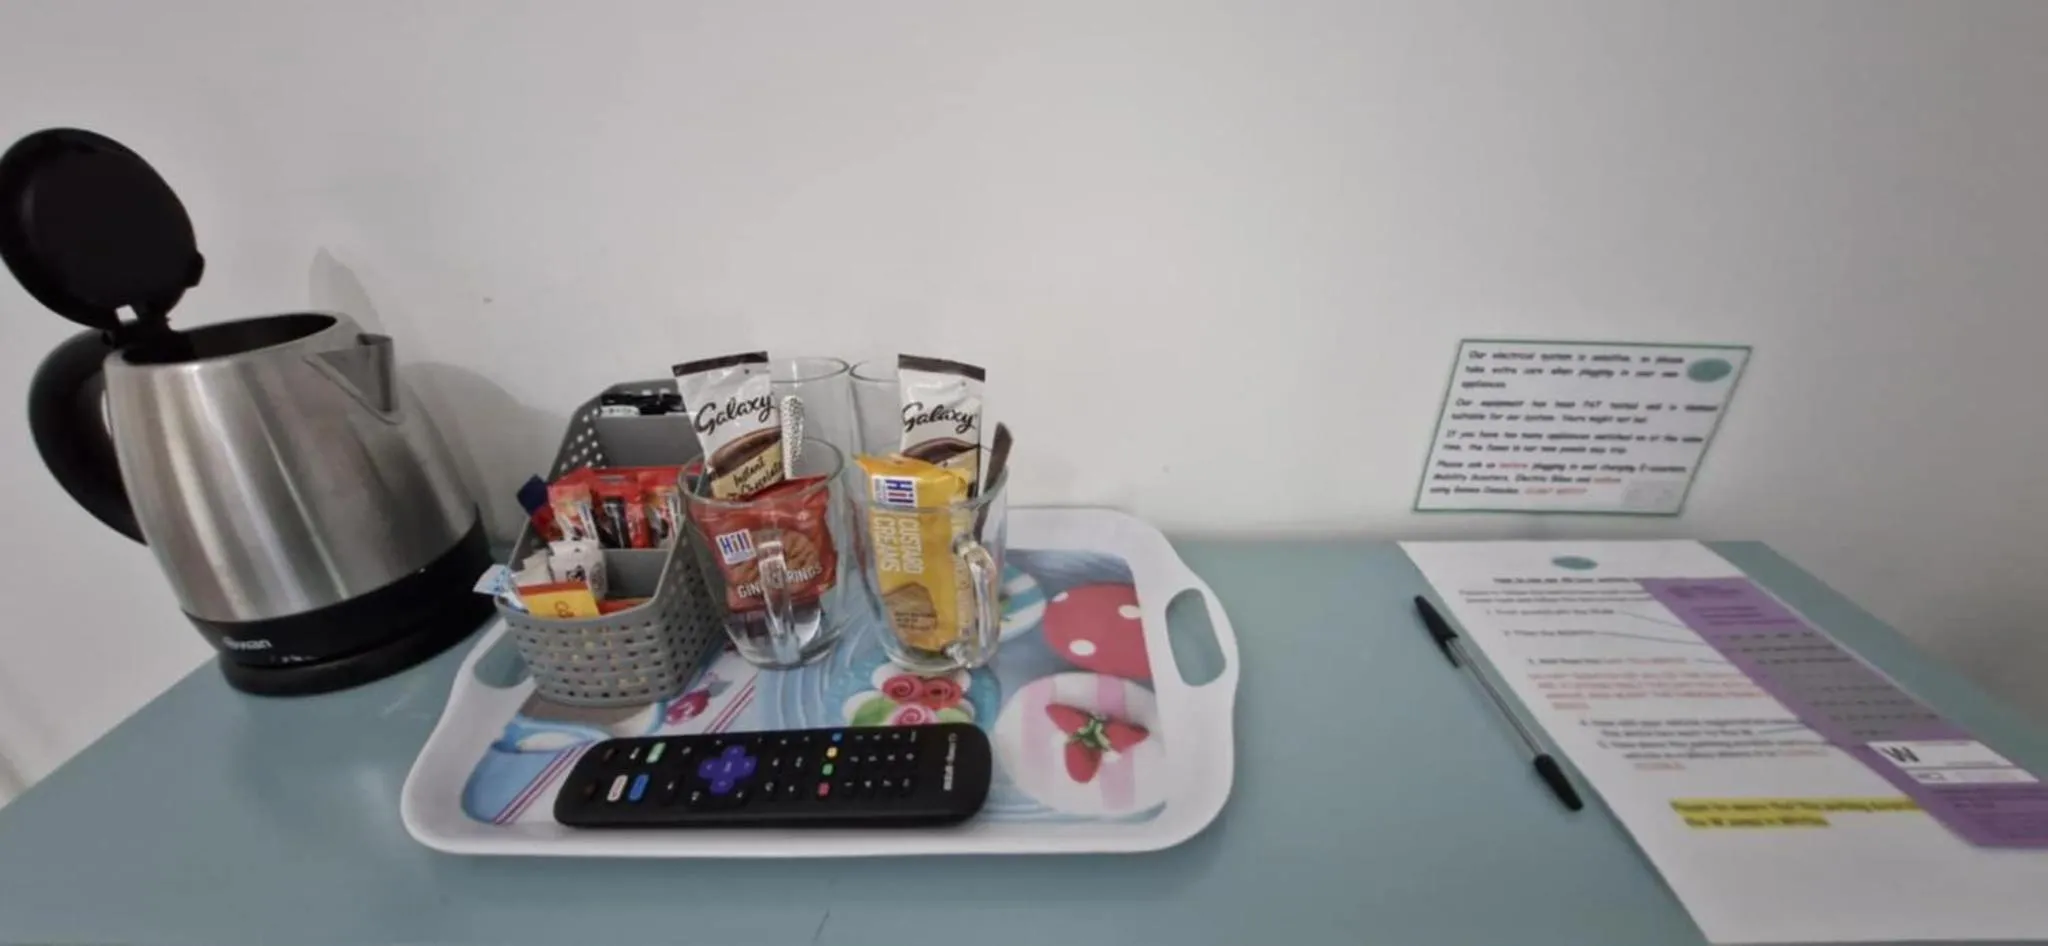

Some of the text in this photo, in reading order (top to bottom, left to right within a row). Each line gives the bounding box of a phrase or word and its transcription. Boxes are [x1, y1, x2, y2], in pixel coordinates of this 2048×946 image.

[694, 394, 777, 435] Galaxy
[902, 402, 978, 433] Galaxy
[732, 455, 766, 488] Instant
[719, 532, 751, 556] Hill
[873, 517, 900, 573] CREAMS
[899, 518, 924, 575] CUSTARD
